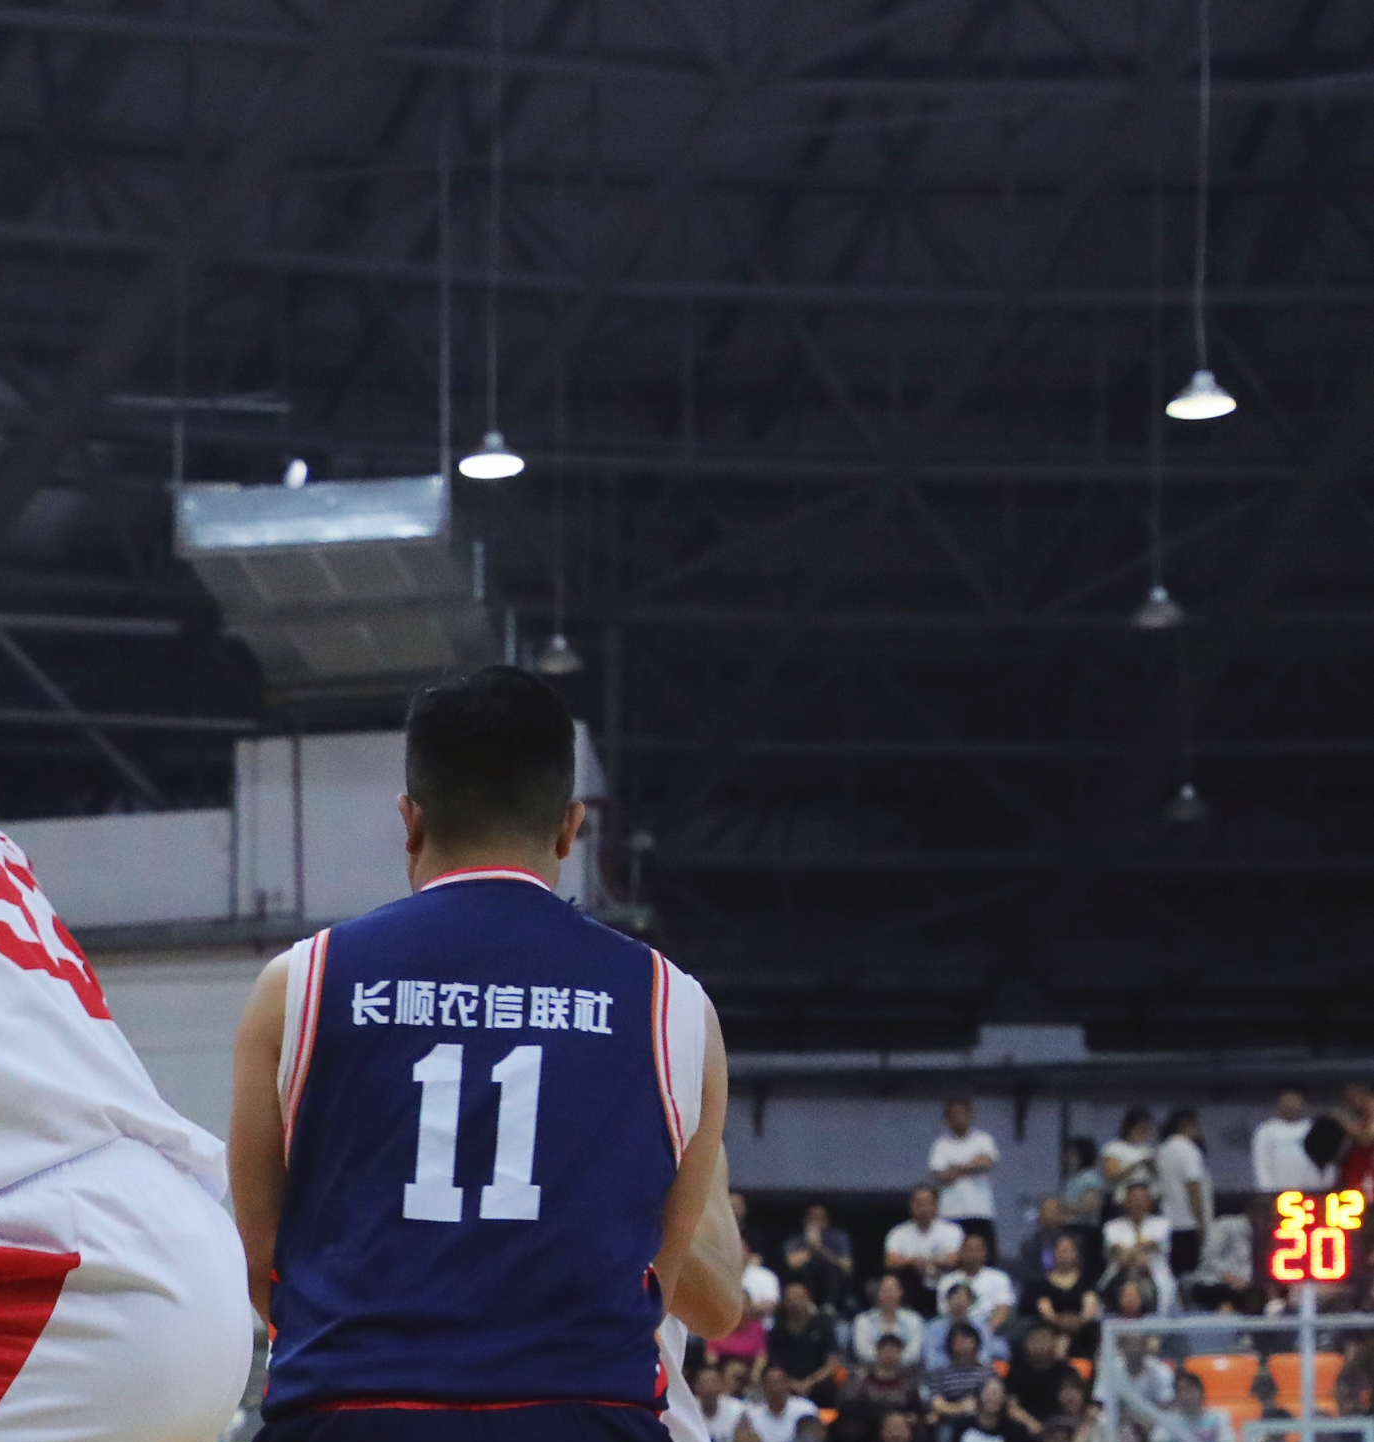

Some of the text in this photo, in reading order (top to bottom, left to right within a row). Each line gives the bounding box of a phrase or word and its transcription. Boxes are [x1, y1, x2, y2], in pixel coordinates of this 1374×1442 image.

[351, 980, 614, 1035] 长顺农信联社
[403, 1043, 543, 1222] 11
[1271, 1226, 1349, 1281] 20
